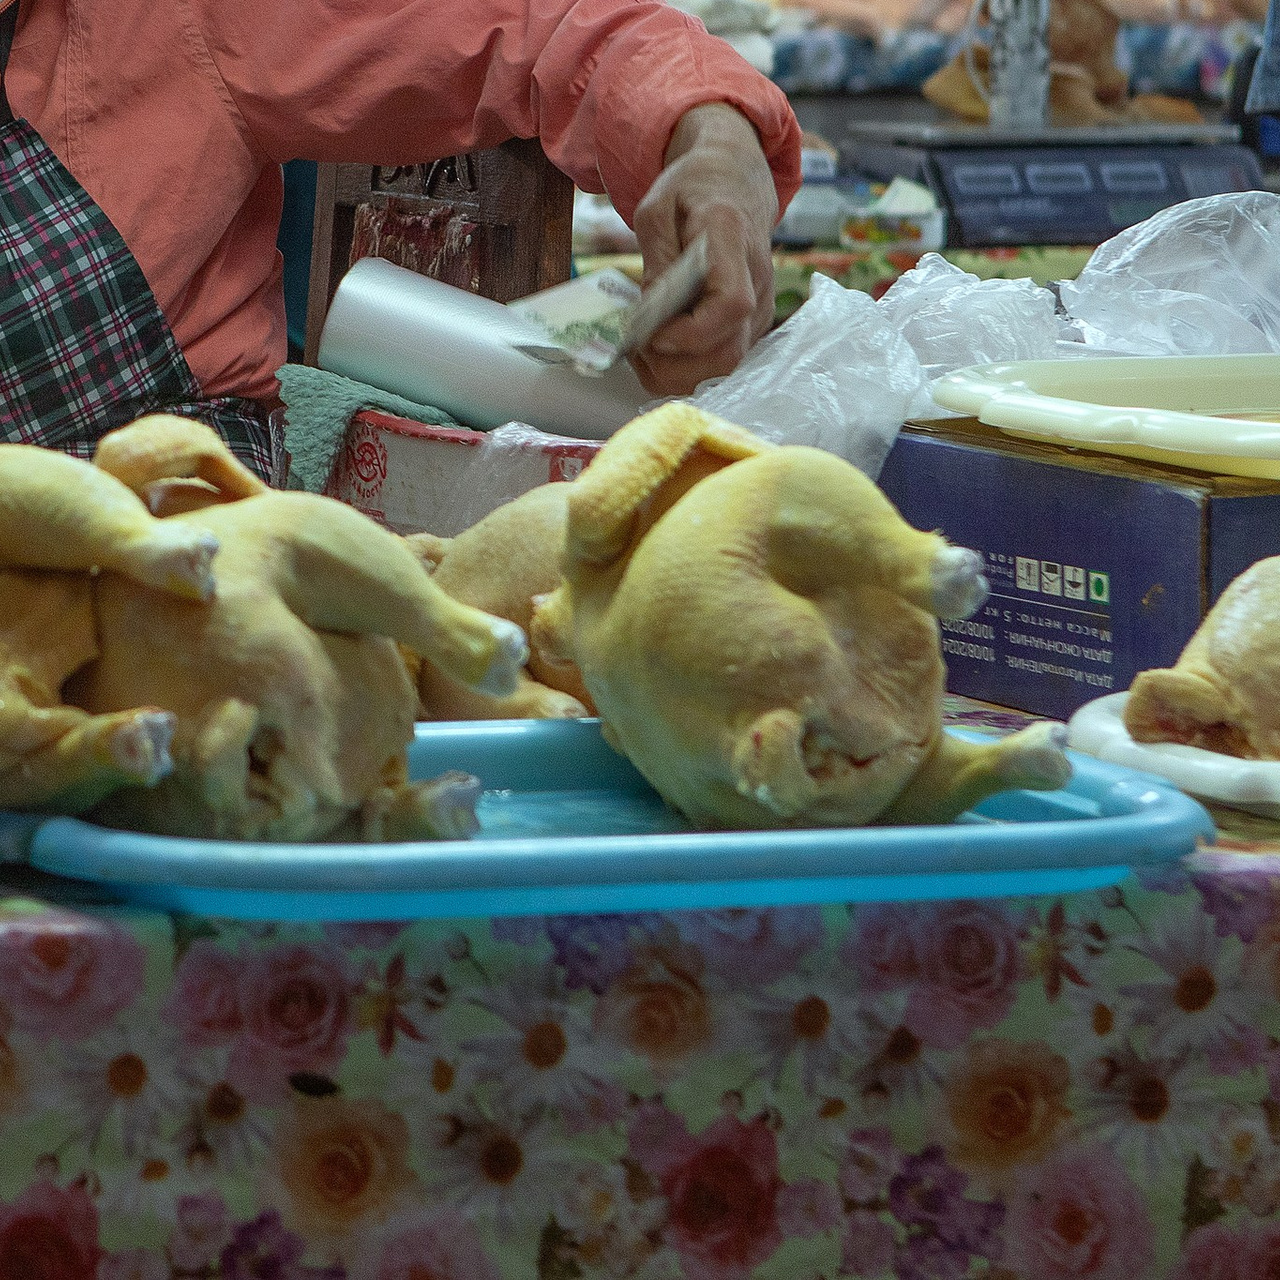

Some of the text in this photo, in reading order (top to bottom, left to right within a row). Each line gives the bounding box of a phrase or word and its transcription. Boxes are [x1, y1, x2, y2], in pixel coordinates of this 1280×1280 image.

[1003, 610, 1012, 622] 5
[1067, 622, 1112, 643] Масса
[1081, 647, 1113, 663] ДАТА
[1085, 672, 1113, 689] ДАТА
